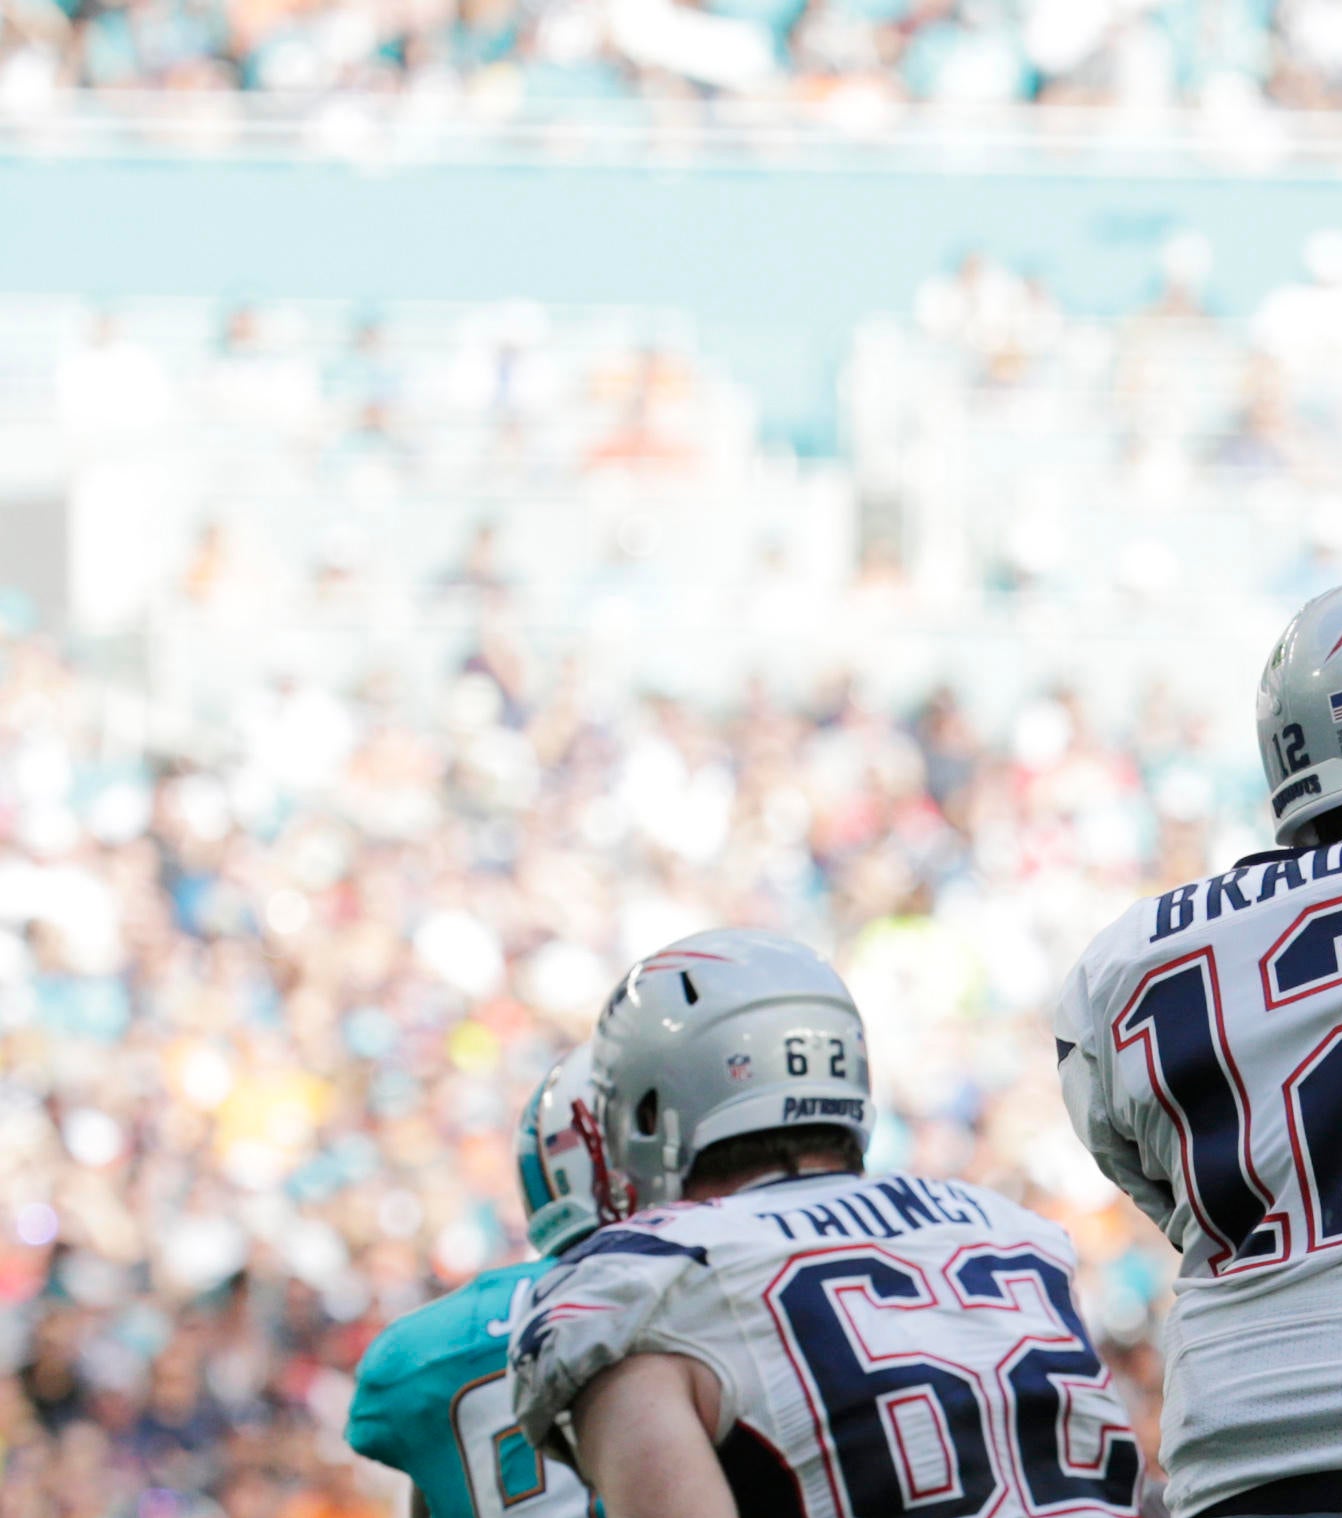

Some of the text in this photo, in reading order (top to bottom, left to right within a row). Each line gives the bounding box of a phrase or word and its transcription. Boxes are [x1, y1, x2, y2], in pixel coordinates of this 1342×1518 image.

[1272, 722, 1312, 777] 12
[785, 1037, 847, 1079] 62
[782, 1096, 865, 1124] PATRIOTS
